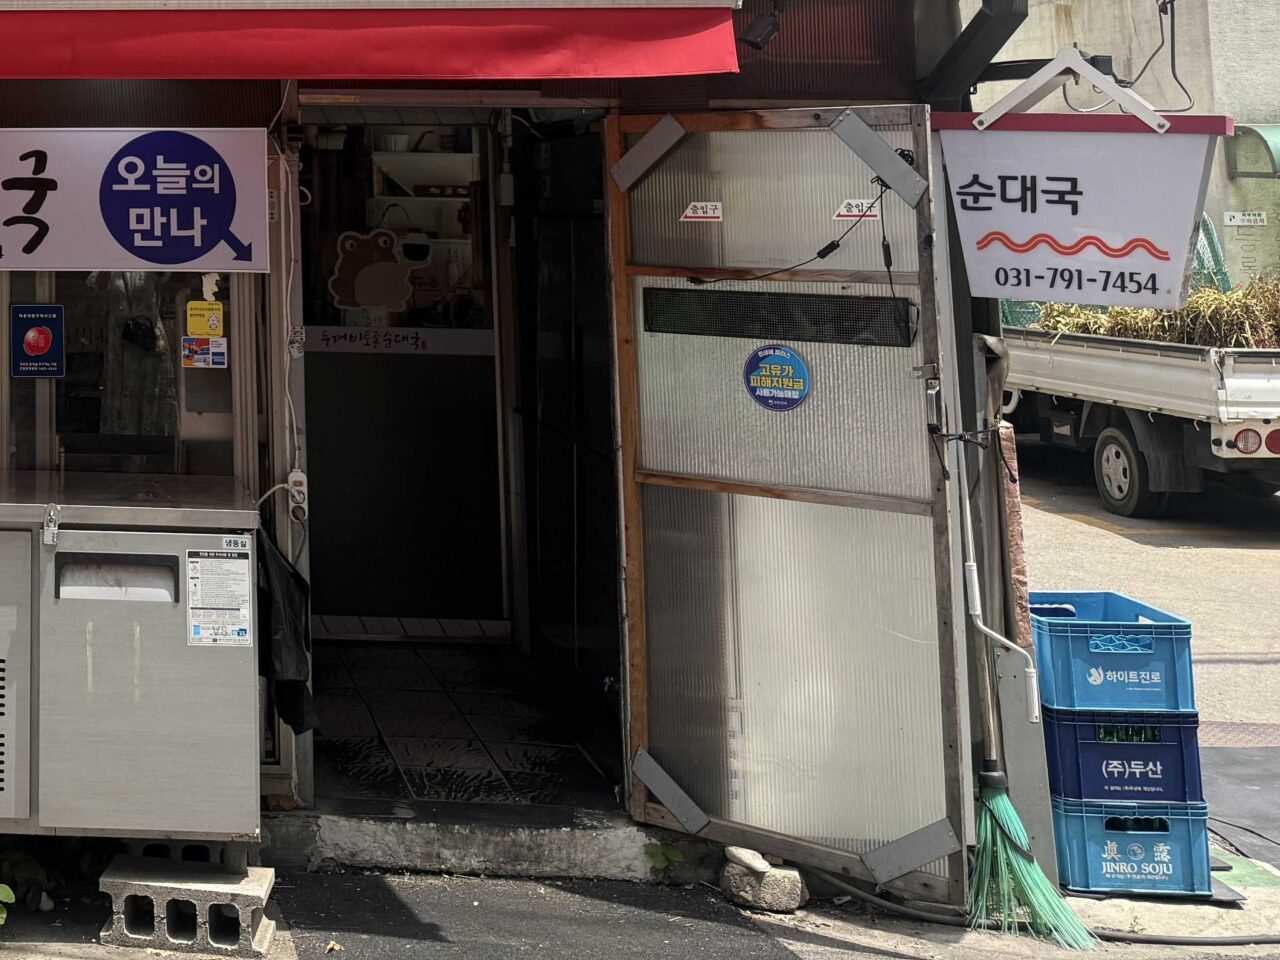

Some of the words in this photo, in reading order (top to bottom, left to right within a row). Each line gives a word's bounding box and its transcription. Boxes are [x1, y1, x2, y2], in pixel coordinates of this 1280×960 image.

[111, 155, 221, 195] 오늘의
[955, 173, 1084, 216] 순대국
[690, 204, 719, 215] 출입구
[128, 206, 208, 248] 만나
[994, 266, 1160, 295] 031-791-7454
[758, 363, 794, 376] 고유가
[750, 375, 804, 390] 피해지원금
[1105, 669, 1162, 684] 하이트진로
[1101, 759, 1163, 779] (주)두산
[1101, 861, 1138, 874] JINRO
[1141, 862, 1174, 876] SOJU
